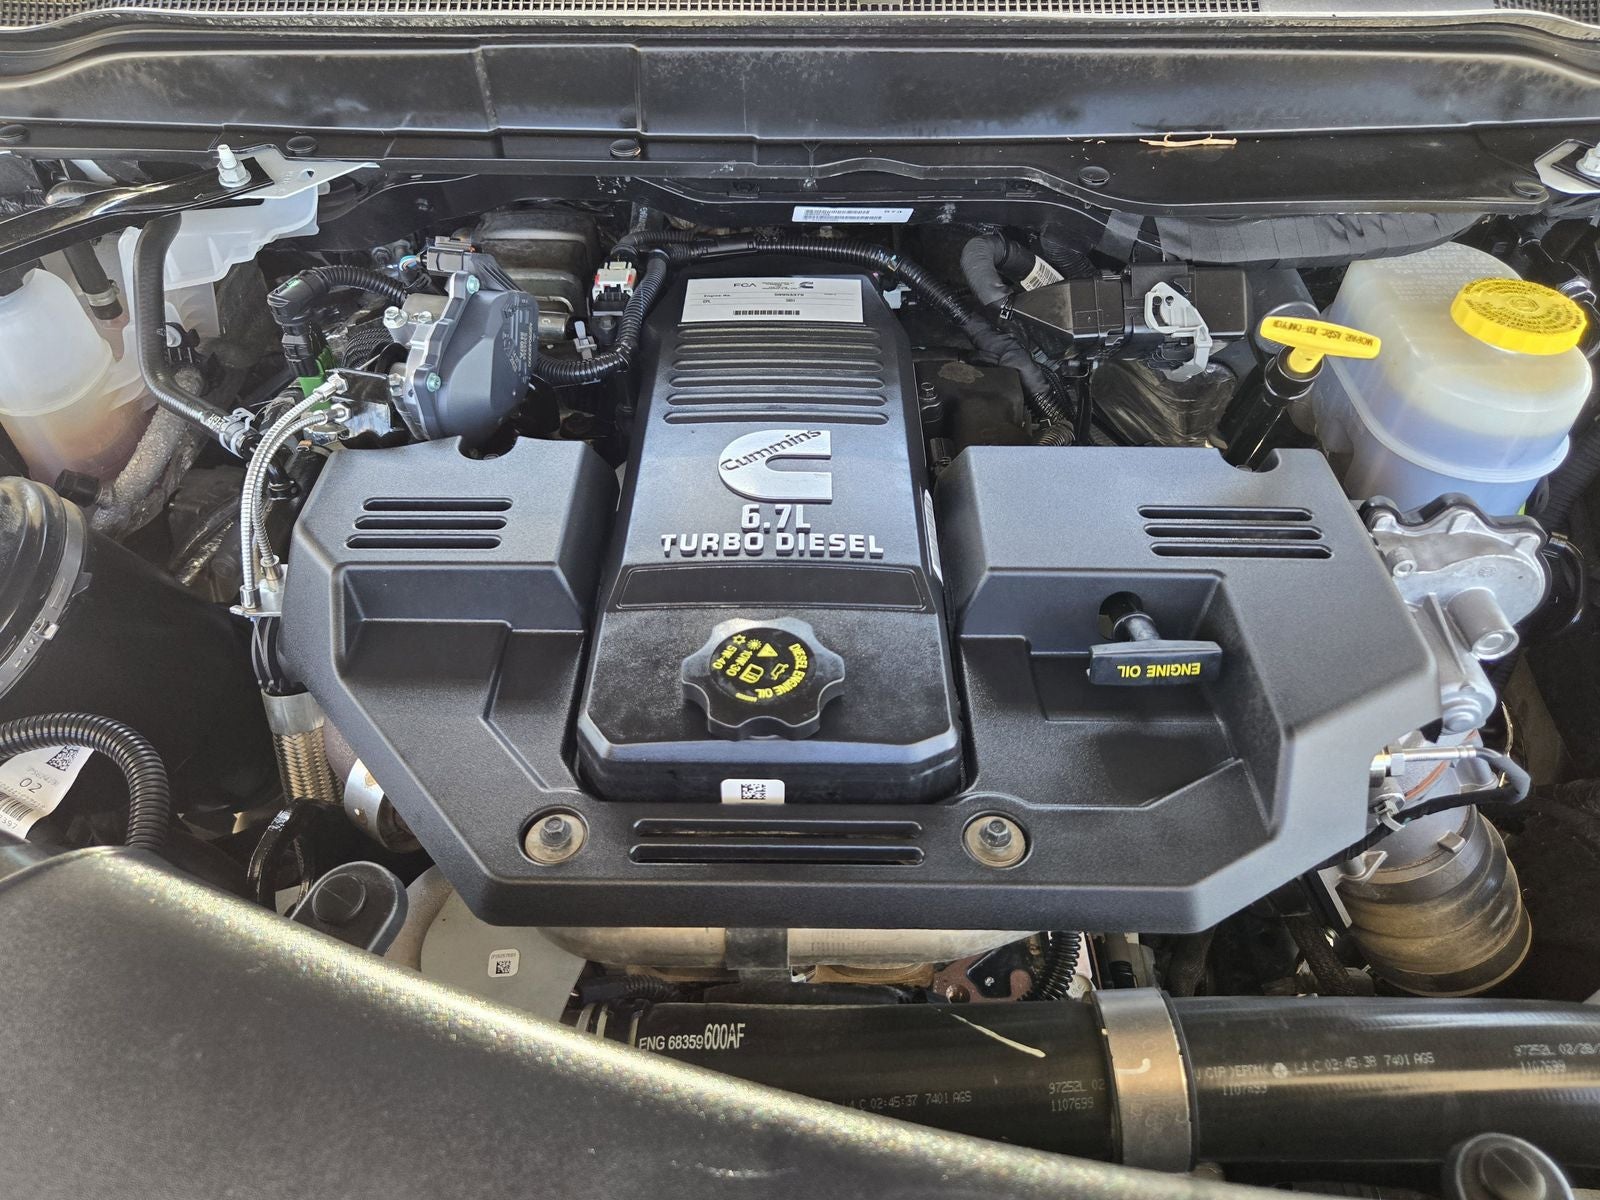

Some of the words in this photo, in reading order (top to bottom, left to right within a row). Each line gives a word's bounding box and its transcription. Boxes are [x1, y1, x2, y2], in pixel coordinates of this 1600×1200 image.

[720, 430, 822, 471] Cummins
[741, 504, 811, 533] 6.7L
[661, 532, 765, 557] TURBO
[776, 533, 884, 559] DIESEL
[712, 644, 738, 670] 5W-40
[725, 650, 753, 677] 10W-30
[788, 643, 808, 670] DIESEL
[1117, 665, 1142, 678] OIL
[1146, 662, 1201, 678] ENGINE
[755, 687, 774, 699] OIL
[772, 669, 806, 696] ENGINE
[19, 777, 43, 794] 02
[639, 1035, 666, 1050] ENG
[1414, 1051, 1435, 1065] AGS
[925, 1092, 949, 1105] 7401
[953, 1091, 972, 1104] AGS
